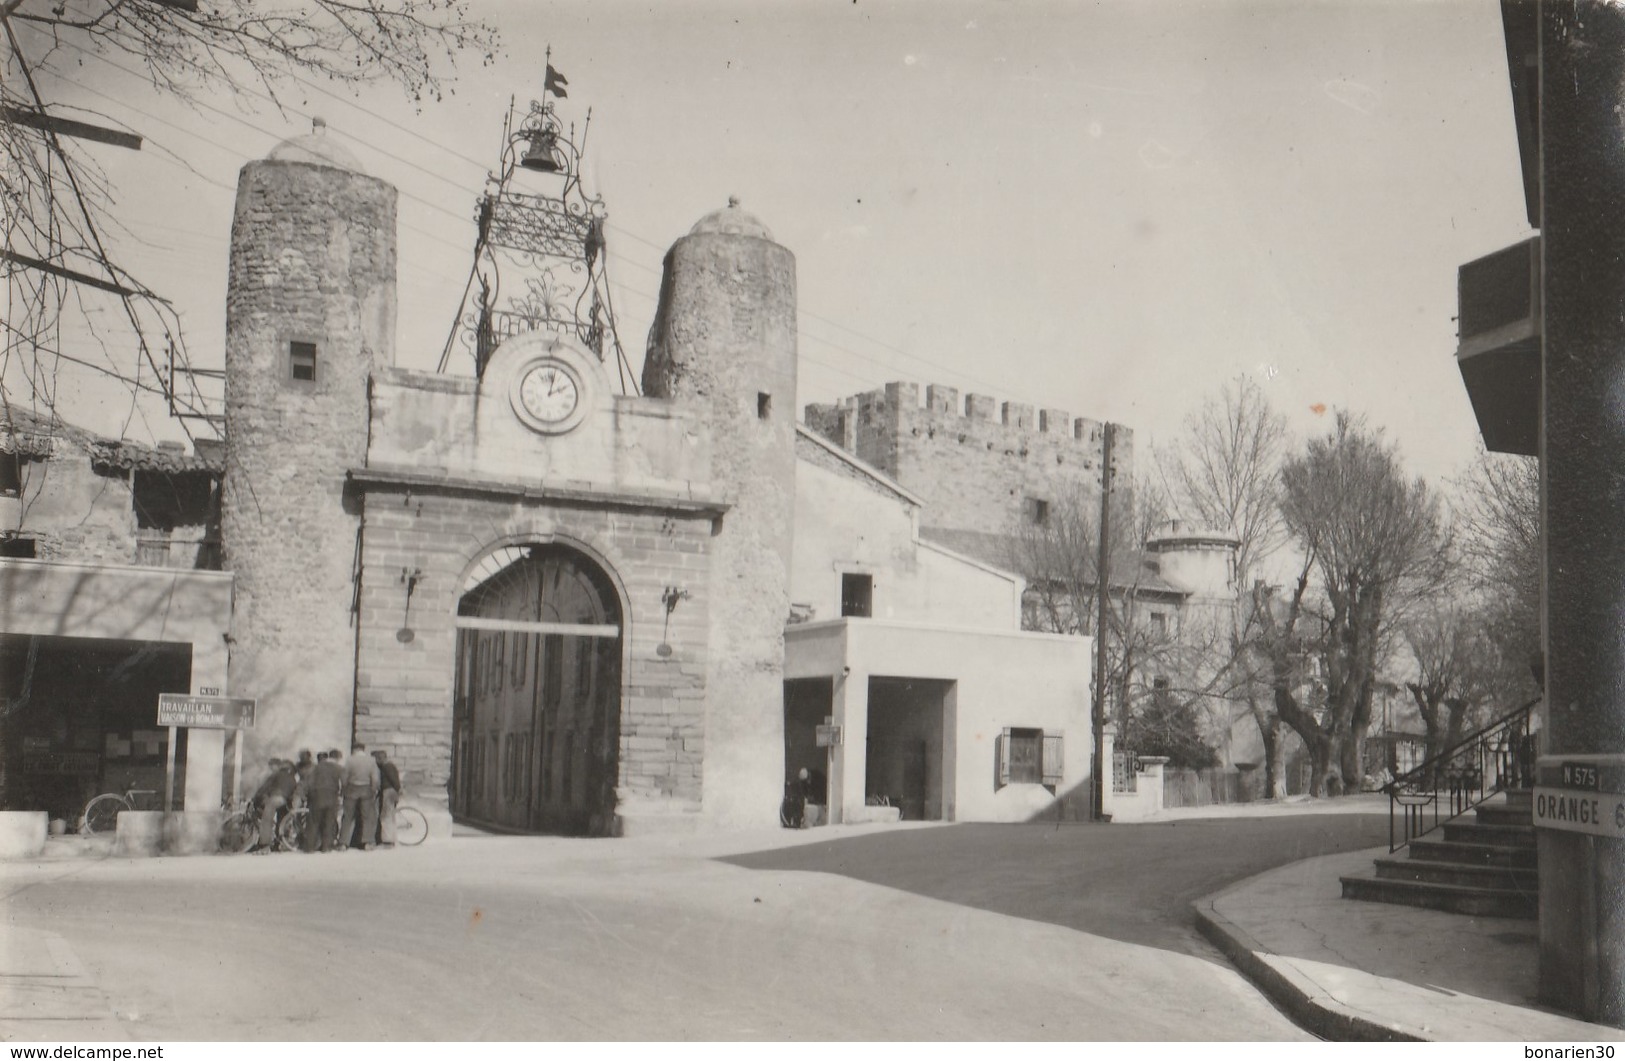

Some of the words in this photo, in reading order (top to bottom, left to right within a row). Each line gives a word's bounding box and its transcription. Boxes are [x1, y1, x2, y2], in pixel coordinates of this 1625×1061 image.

[161, 702, 212, 714] TRAVAILLAN
[161, 712, 186, 723] VAISON
[1564, 766, 1571, 784] N
[1575, 768, 1596, 786] 575
[1537, 793, 1600, 825] ORANGE
